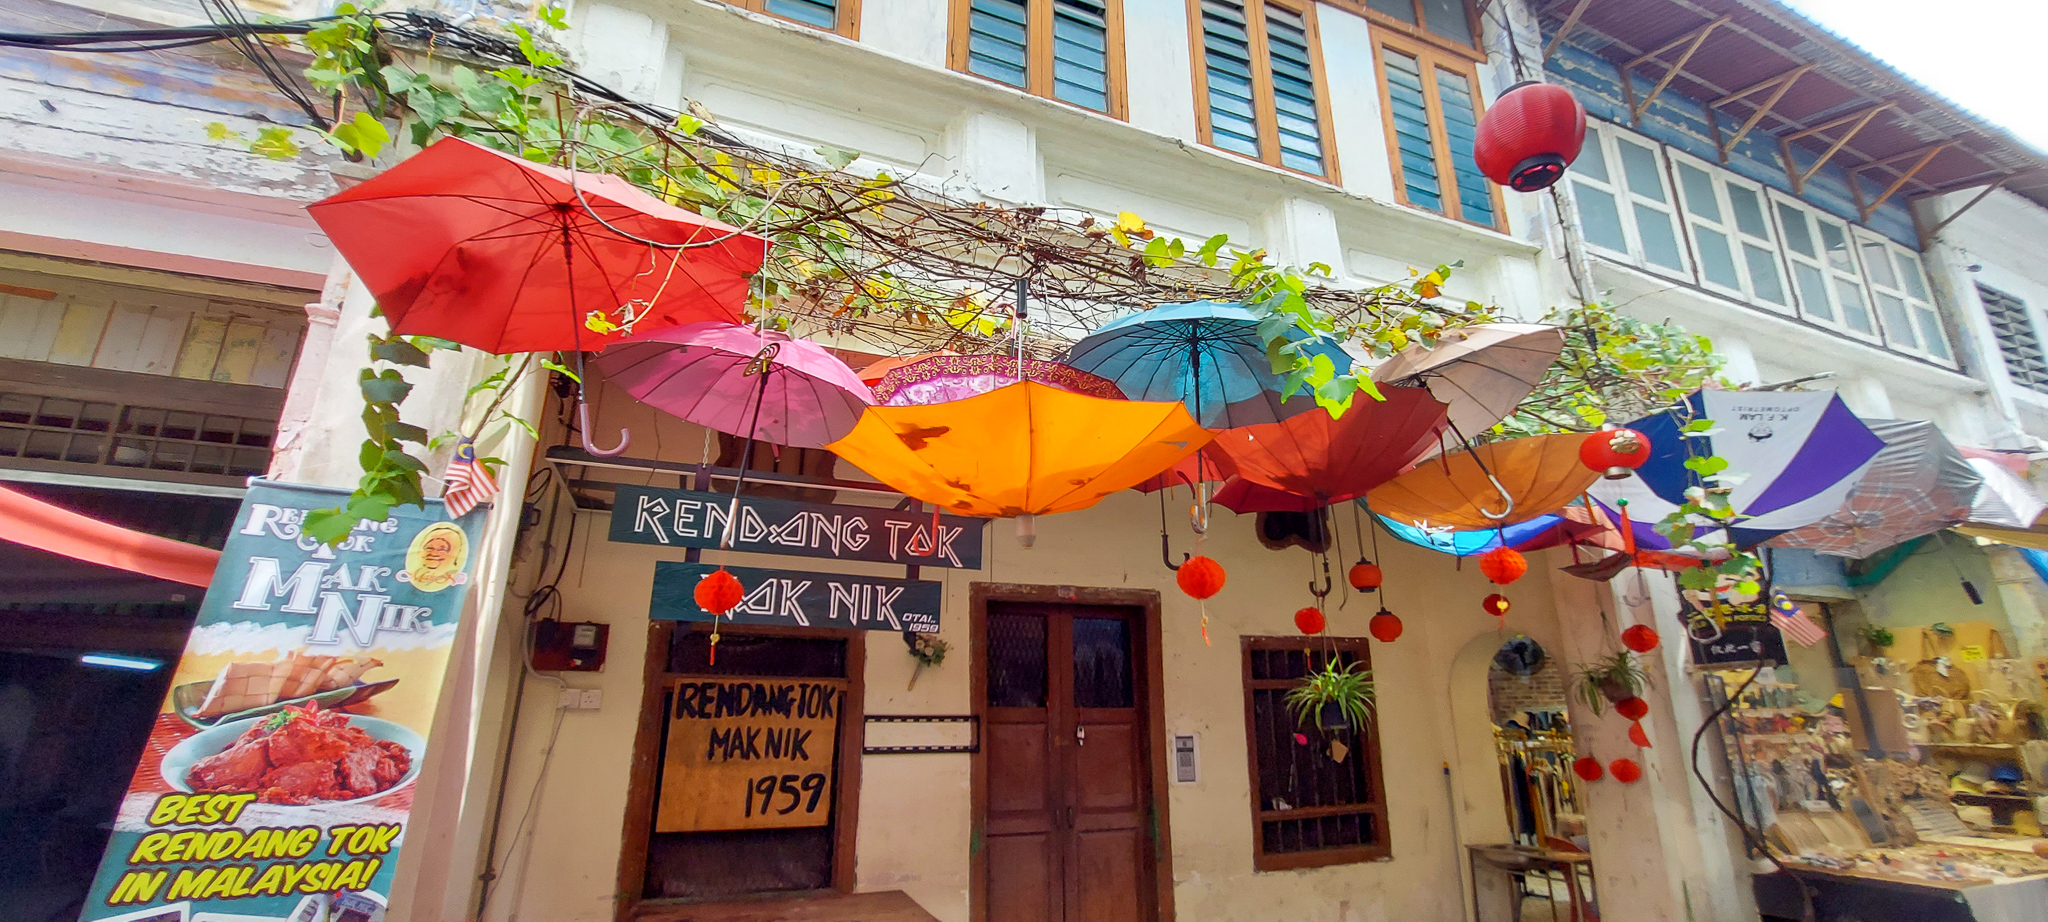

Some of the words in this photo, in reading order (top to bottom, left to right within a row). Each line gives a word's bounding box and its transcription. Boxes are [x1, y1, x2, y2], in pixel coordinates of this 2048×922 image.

[1739, 413, 1763, 421] LAM
[634, 496, 870, 556] RENDANG
[232, 556, 391, 614] MAK
[701, 574, 812, 626] AK
[829, 582, 904, 631] NIK
[305, 591, 432, 647] NIK
[908, 622, 939, 633] 1959
[676, 682, 797, 720] RENDANG
[797, 683, 836, 720] TOK
[707, 726, 762, 762] MAK
[764, 727, 812, 761] NIK
[149, 793, 257, 826] BEST
[744, 772, 827, 818] 1959
[129, 827, 319, 864] RENDANG
[329, 825, 401, 856] TOK
[109, 869, 169, 904] IN
[166, 858, 381, 900] MALAYSIA!
